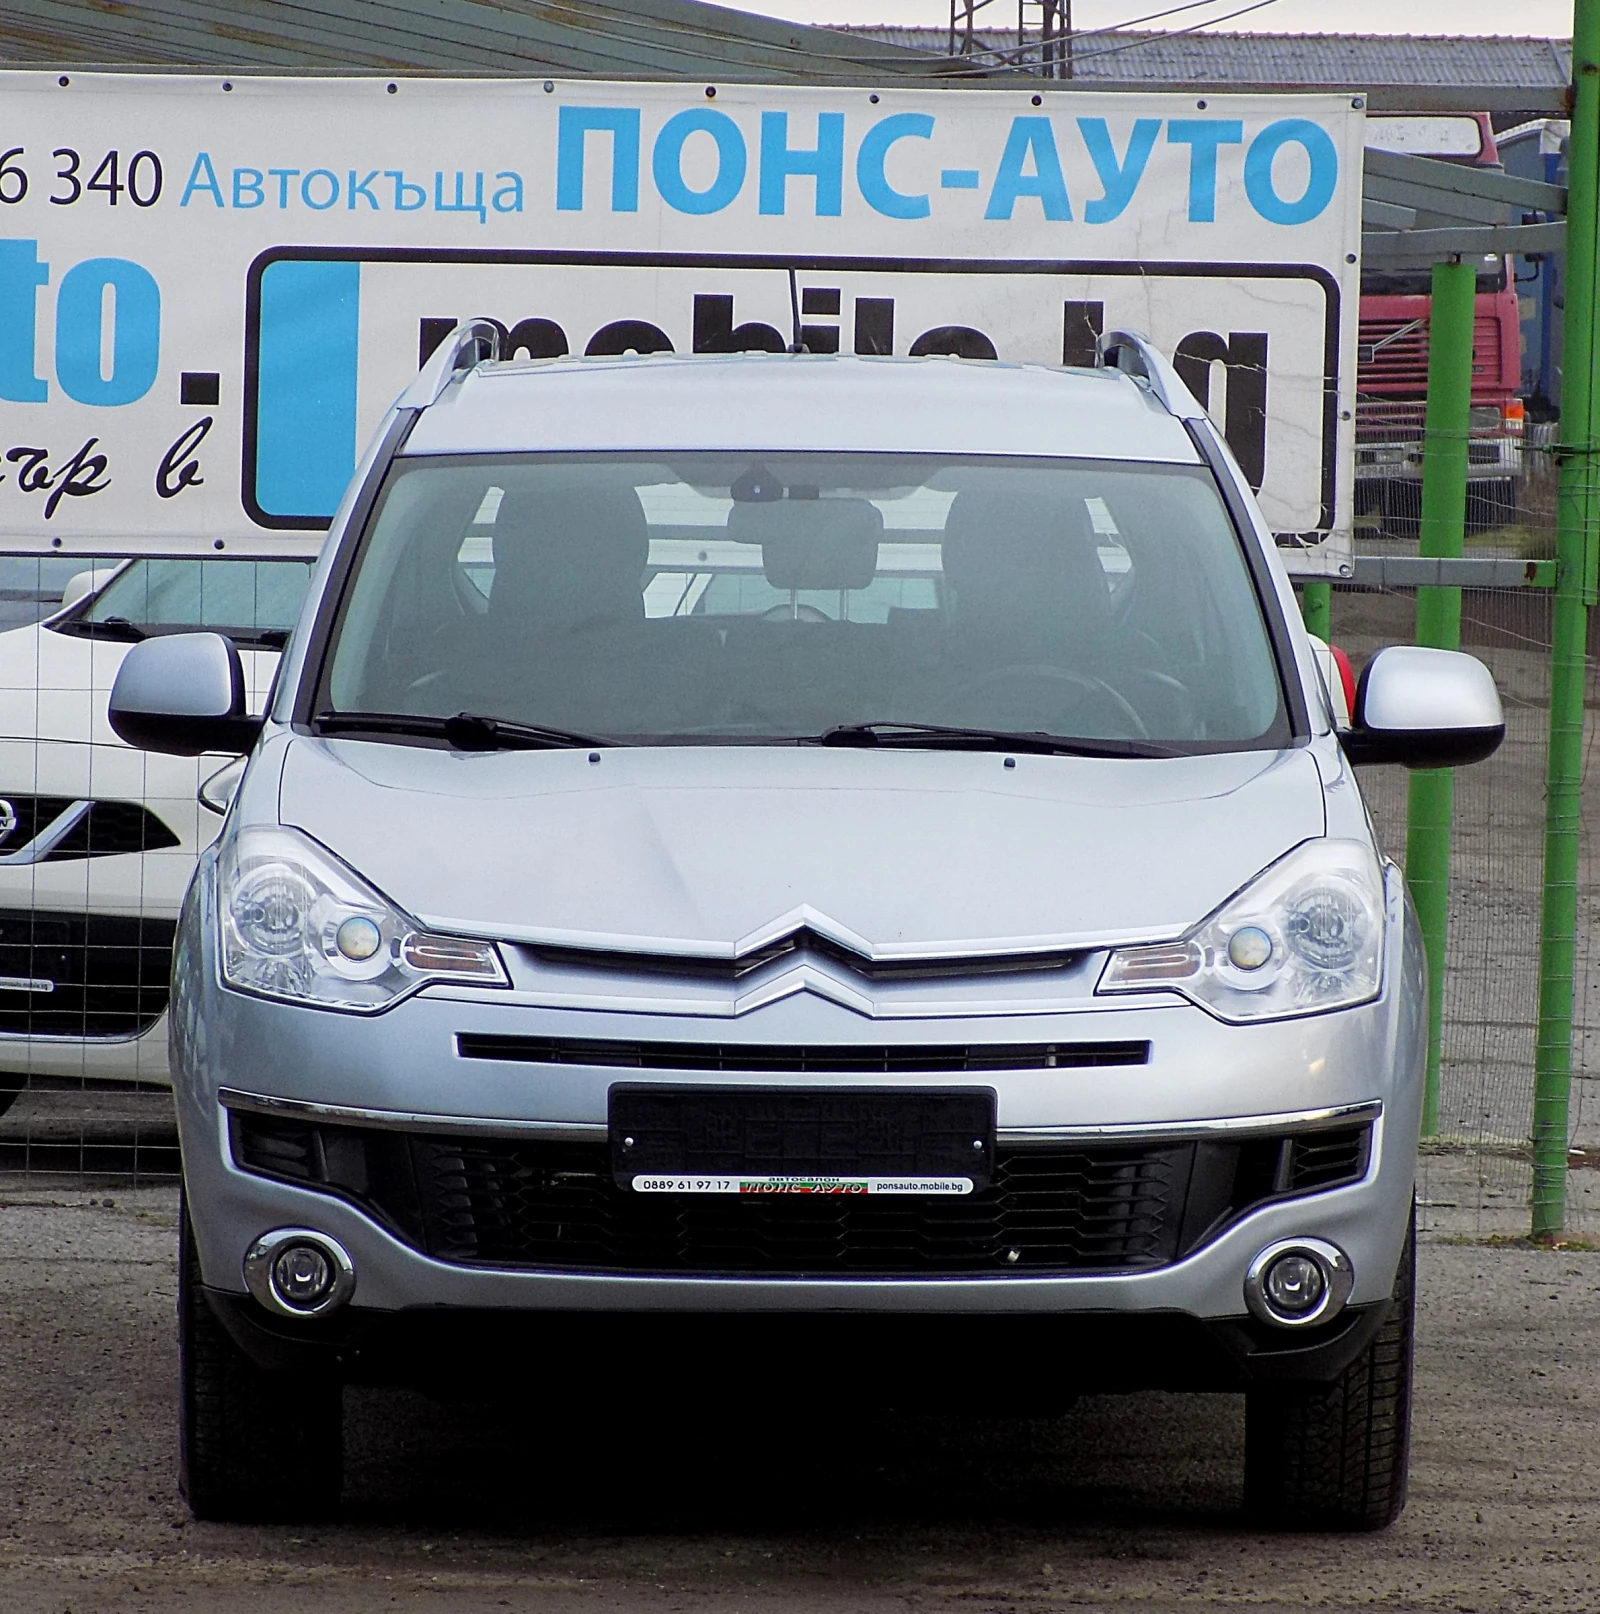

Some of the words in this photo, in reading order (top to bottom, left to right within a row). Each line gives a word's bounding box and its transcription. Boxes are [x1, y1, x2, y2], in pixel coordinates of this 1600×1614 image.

[49, 148, 163, 208] 340
[180, 151, 525, 225] Автокъща
[555, 104, 1339, 226] ПОНС-АУТО
[0, 437, 112, 520] ър
[643, 1180, 674, 1190] 0889
[677, 1180, 692, 1190] 61
[696, 1180, 711, 1190] 97
[717, 1181, 731, 1190] 17
[876, 1181, 964, 1192] ponsauto.mobile.bg
